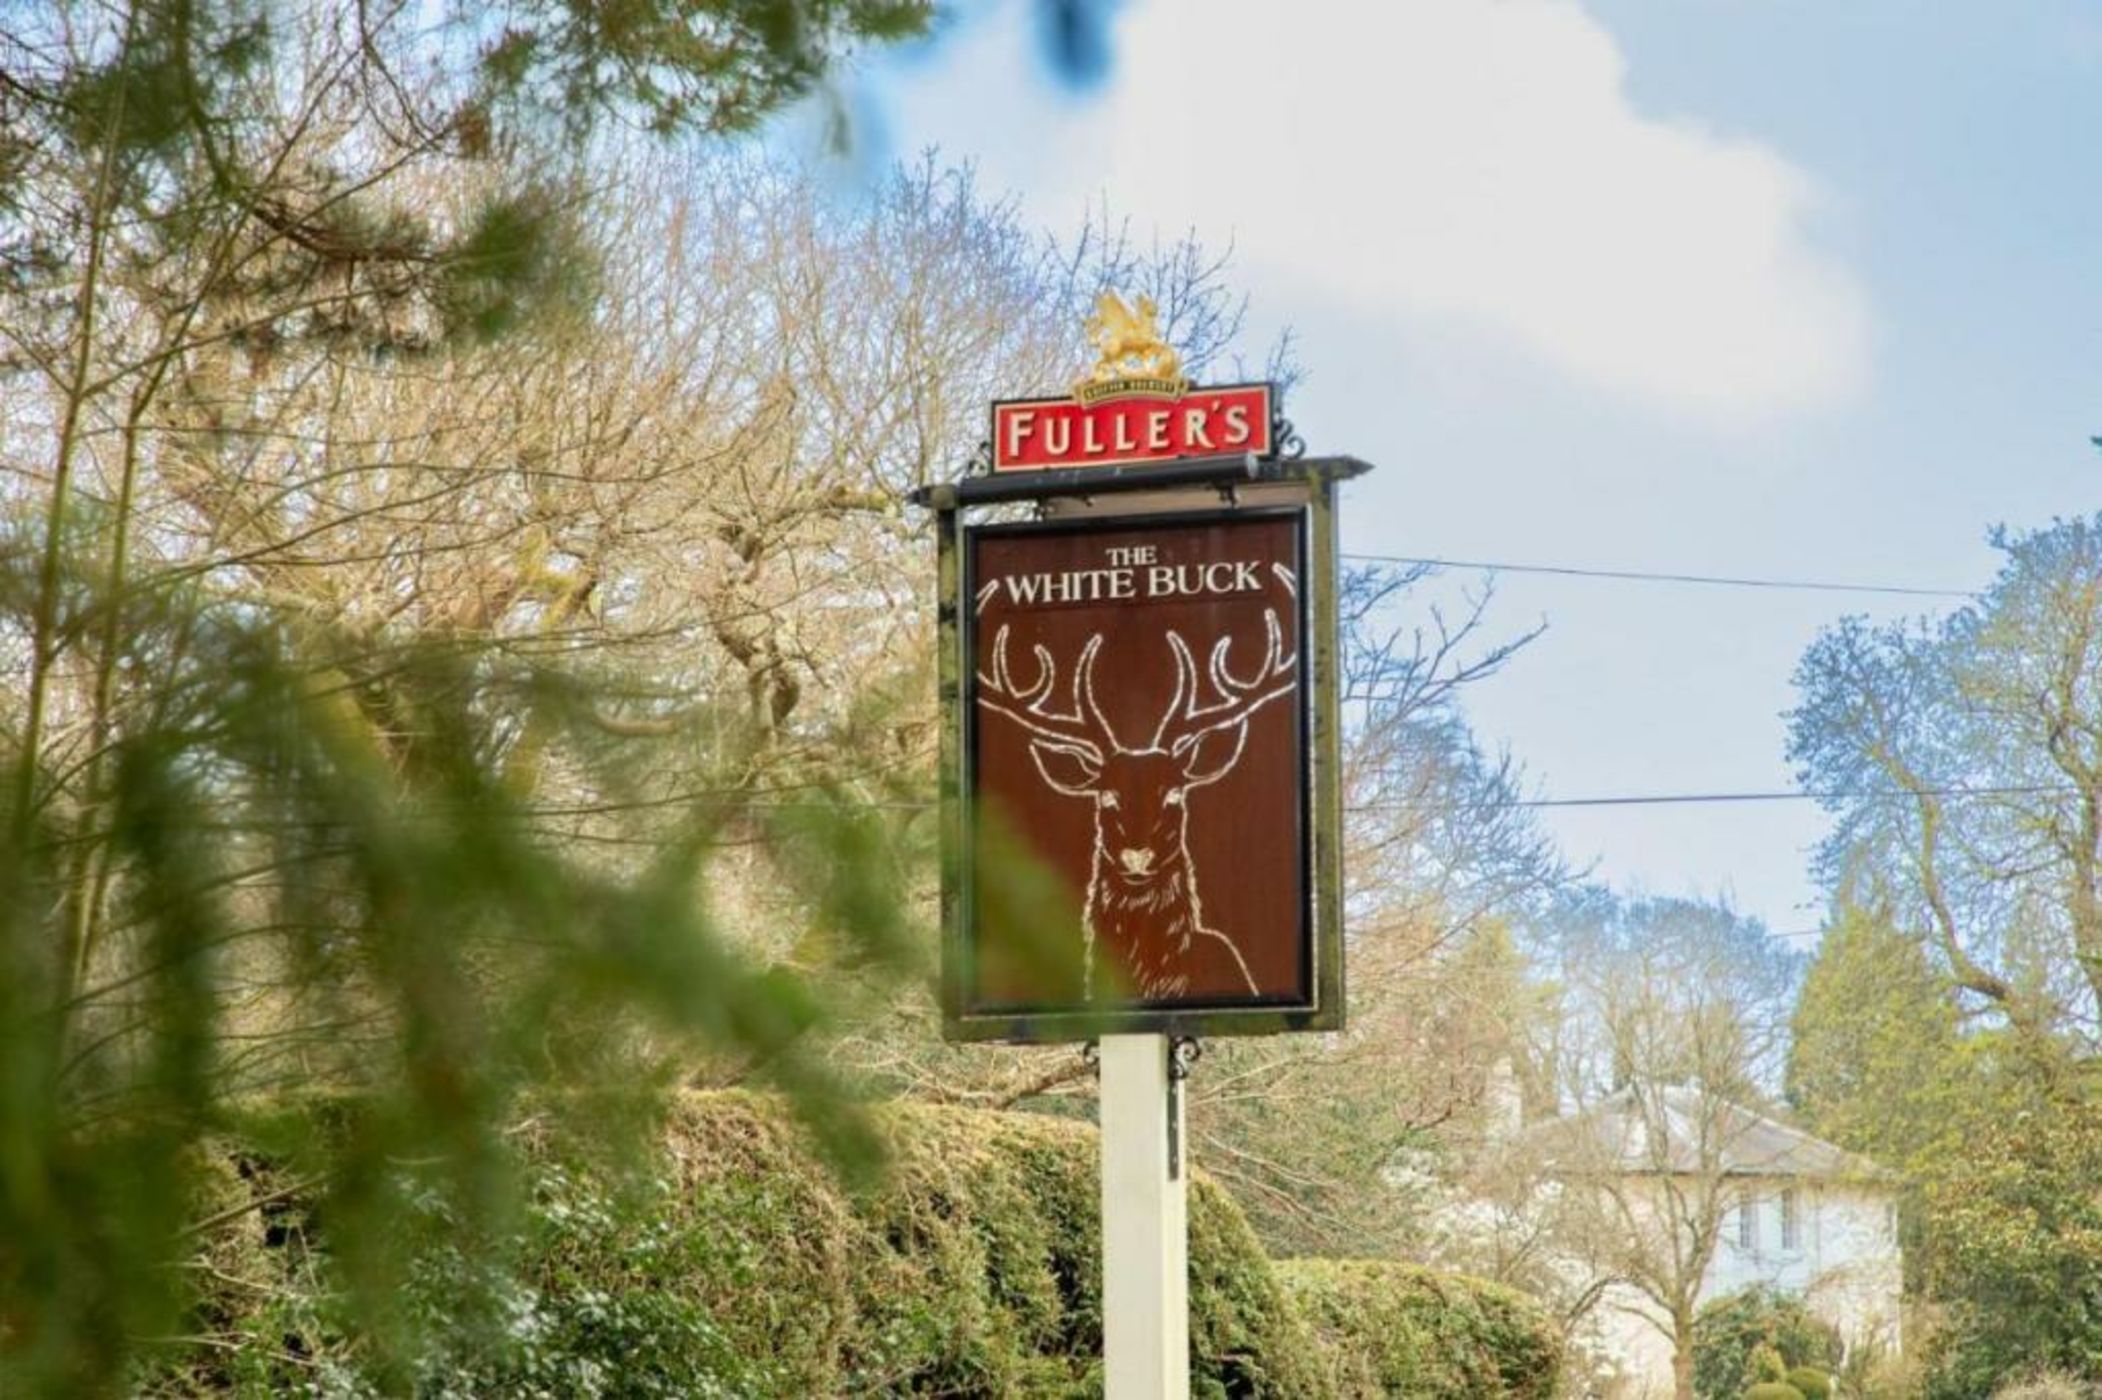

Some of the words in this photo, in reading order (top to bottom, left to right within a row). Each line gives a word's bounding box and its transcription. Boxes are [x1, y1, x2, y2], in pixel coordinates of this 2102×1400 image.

[1008, 400, 1250, 457] FULLER'S
[1105, 546, 1157, 567] THE
[1005, 567, 1136, 605] WHITE
[1147, 560, 1262, 597] BUCK
